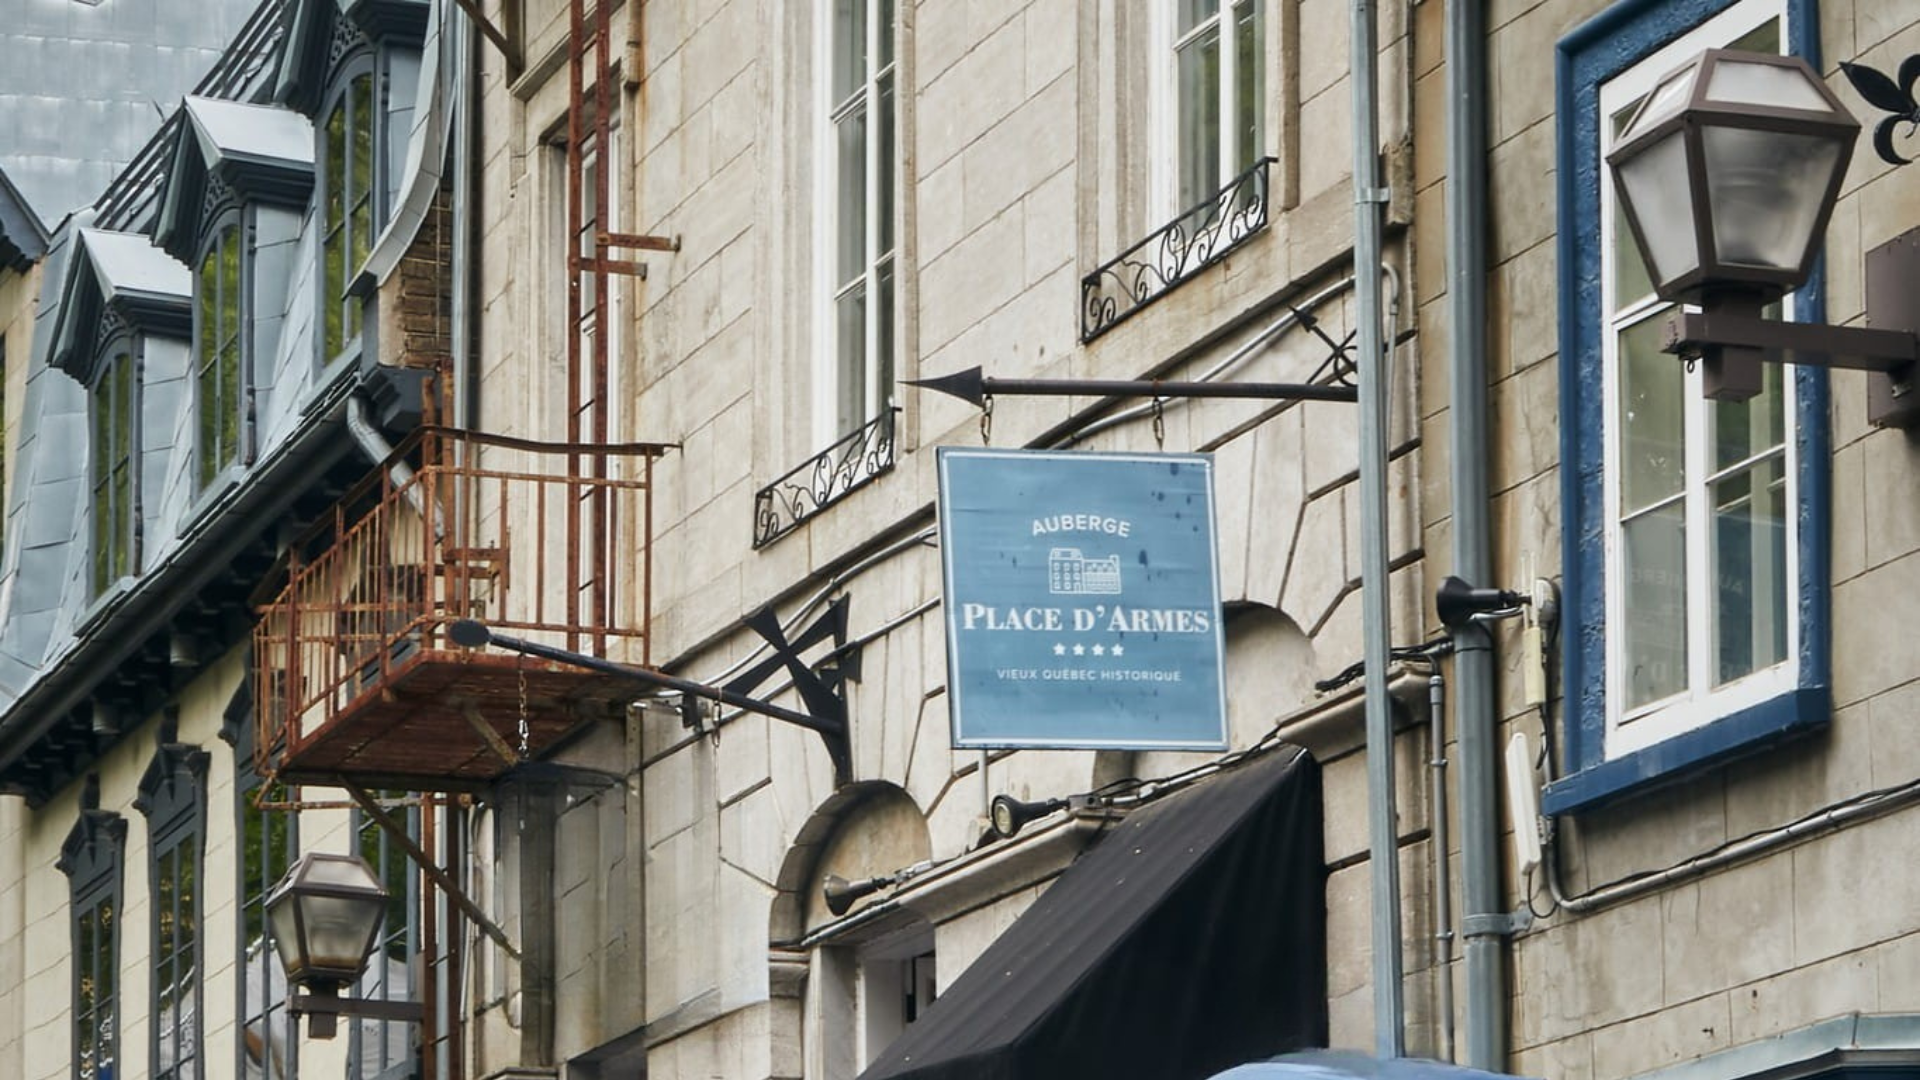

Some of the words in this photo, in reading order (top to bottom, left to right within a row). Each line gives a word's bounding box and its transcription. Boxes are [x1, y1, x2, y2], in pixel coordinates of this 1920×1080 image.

[1032, 513, 1131, 538] AUBERGE
[962, 603, 1063, 631] PLACE
[1073, 604, 1210, 633] D'ARMES
[996, 668, 1038, 680] VIEUX
[1100, 669, 1182, 682] HISTORIQUE
